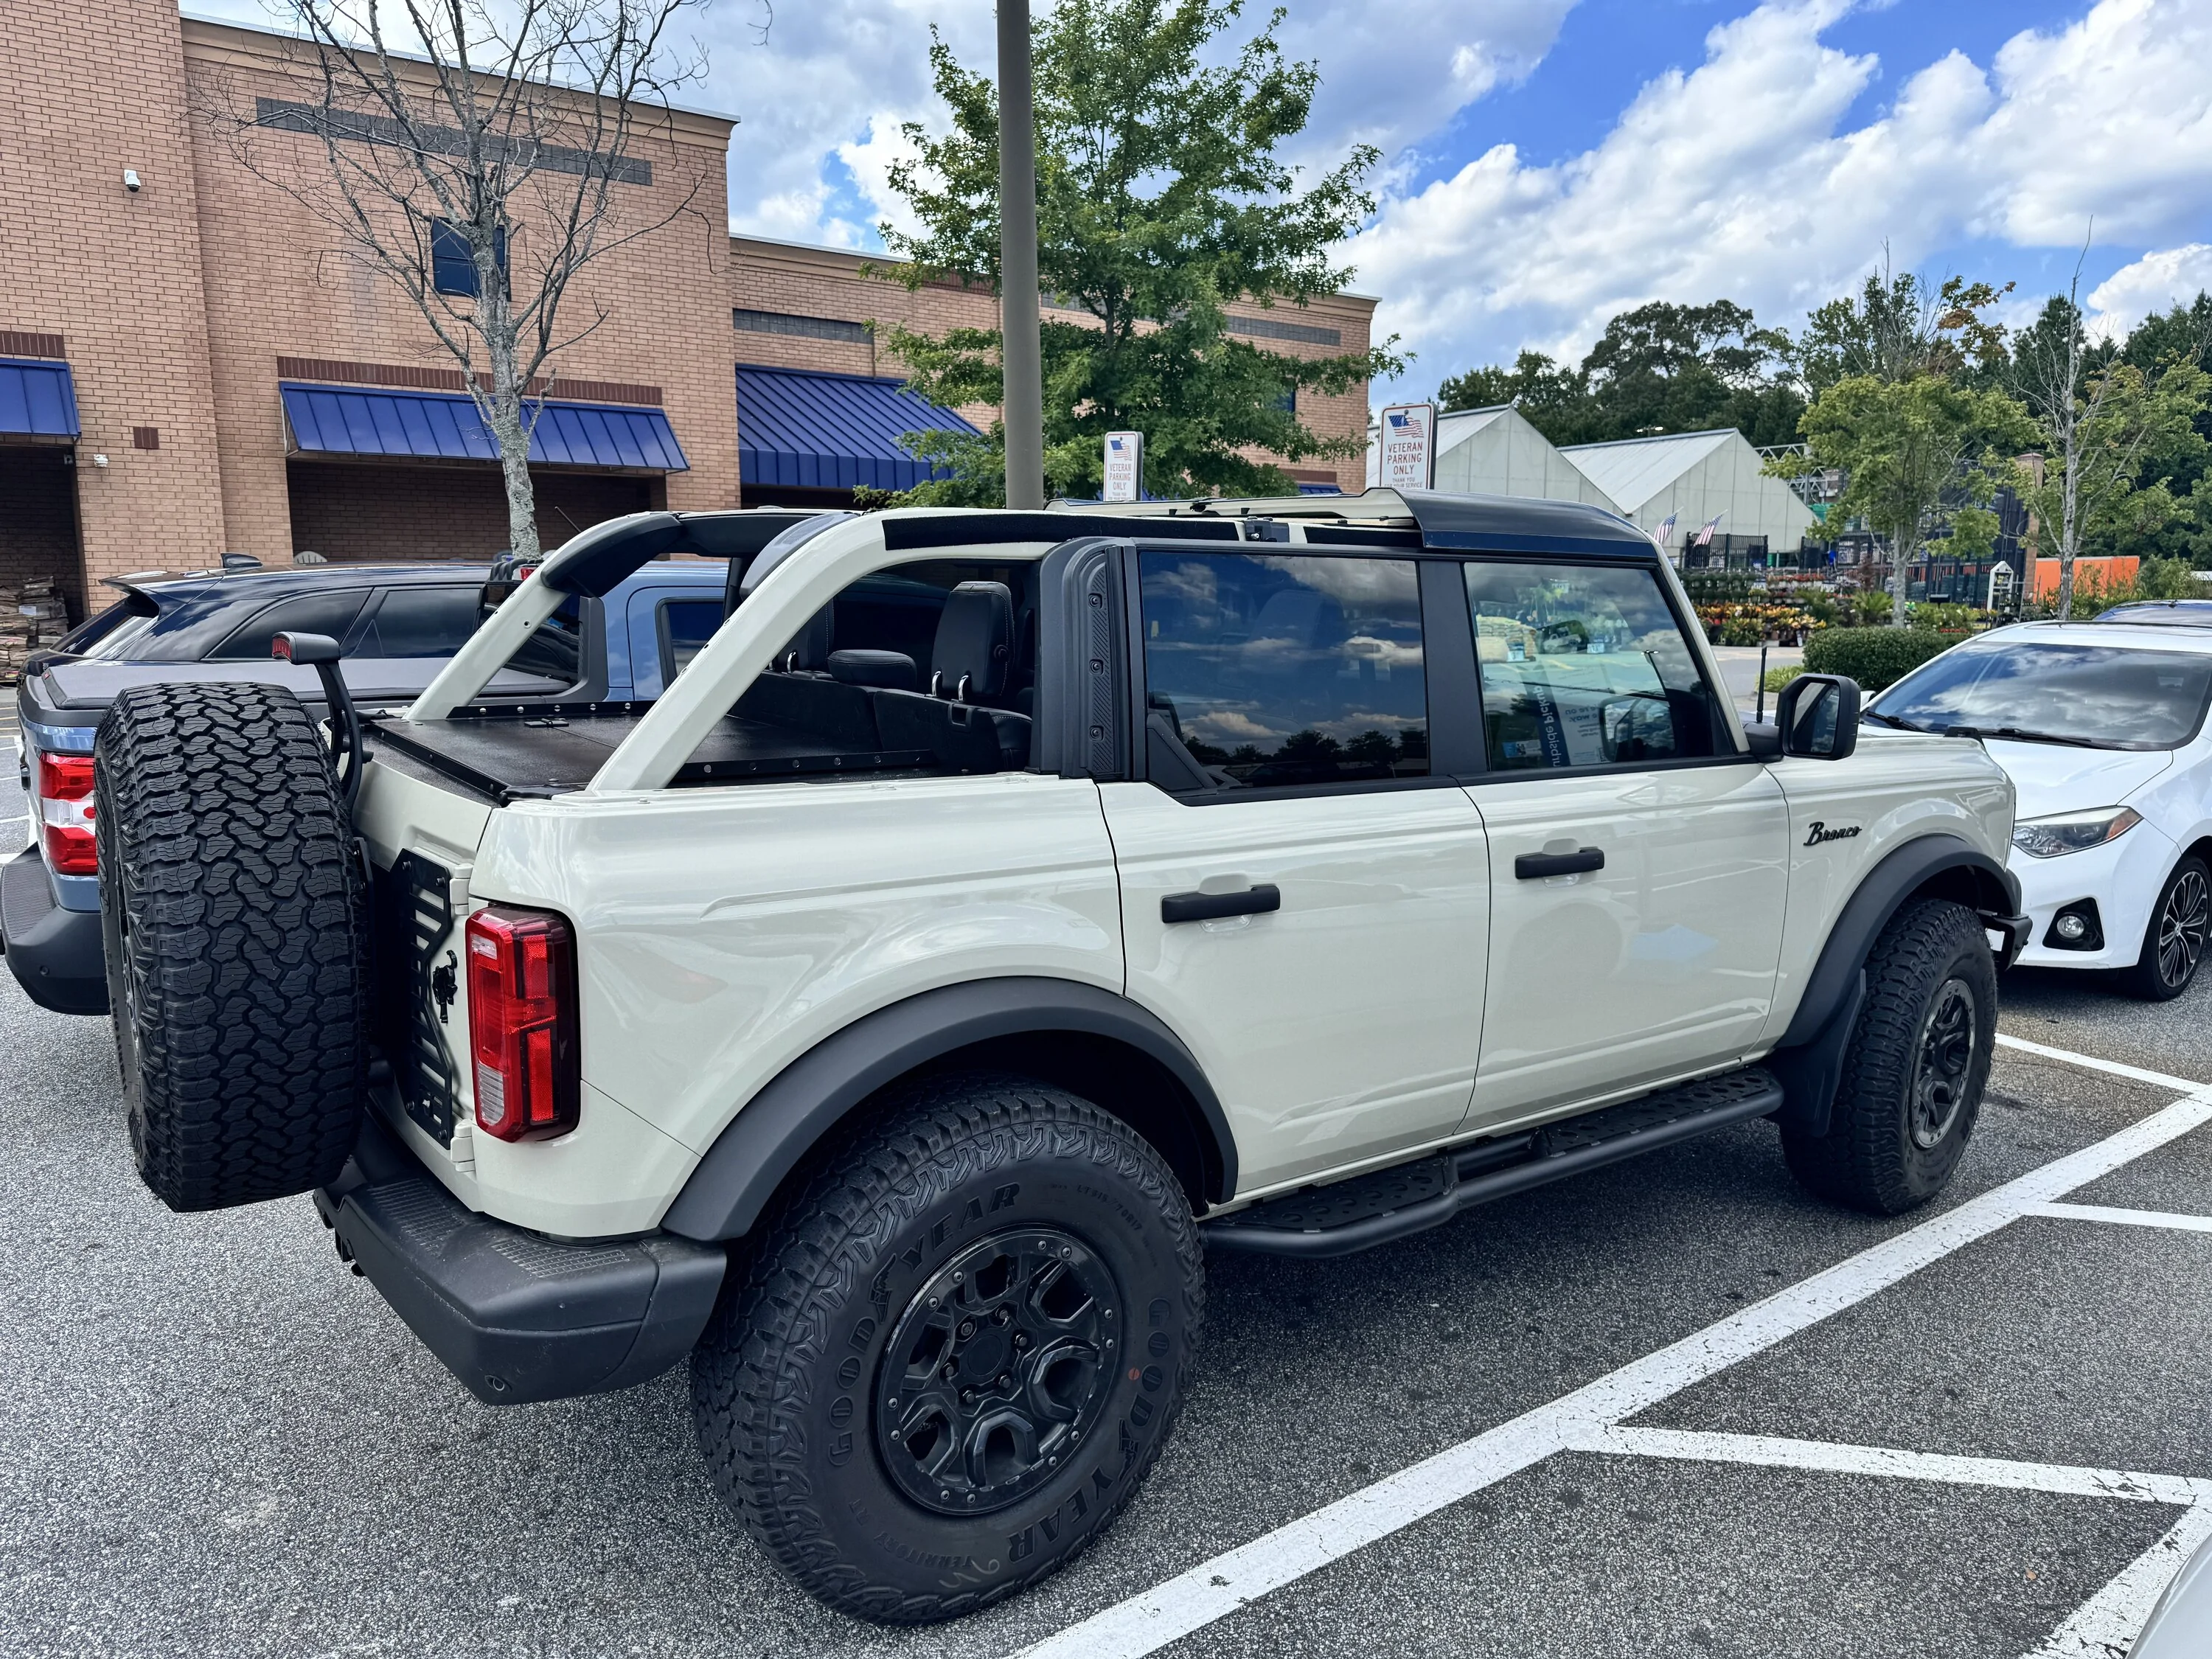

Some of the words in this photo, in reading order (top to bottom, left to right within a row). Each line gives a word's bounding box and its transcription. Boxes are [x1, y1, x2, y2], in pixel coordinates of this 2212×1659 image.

[1388, 442, 1423, 453] VETERAN
[1387, 453, 1422, 465] PARKING
[1109, 463, 1132, 472] VETERAN
[1393, 465, 1414, 475] ONLY
[1109, 473, 1131, 481] PARKING
[1113, 481, 1127, 490] ONLY
[1803, 821, 1863, 846] Bronco
